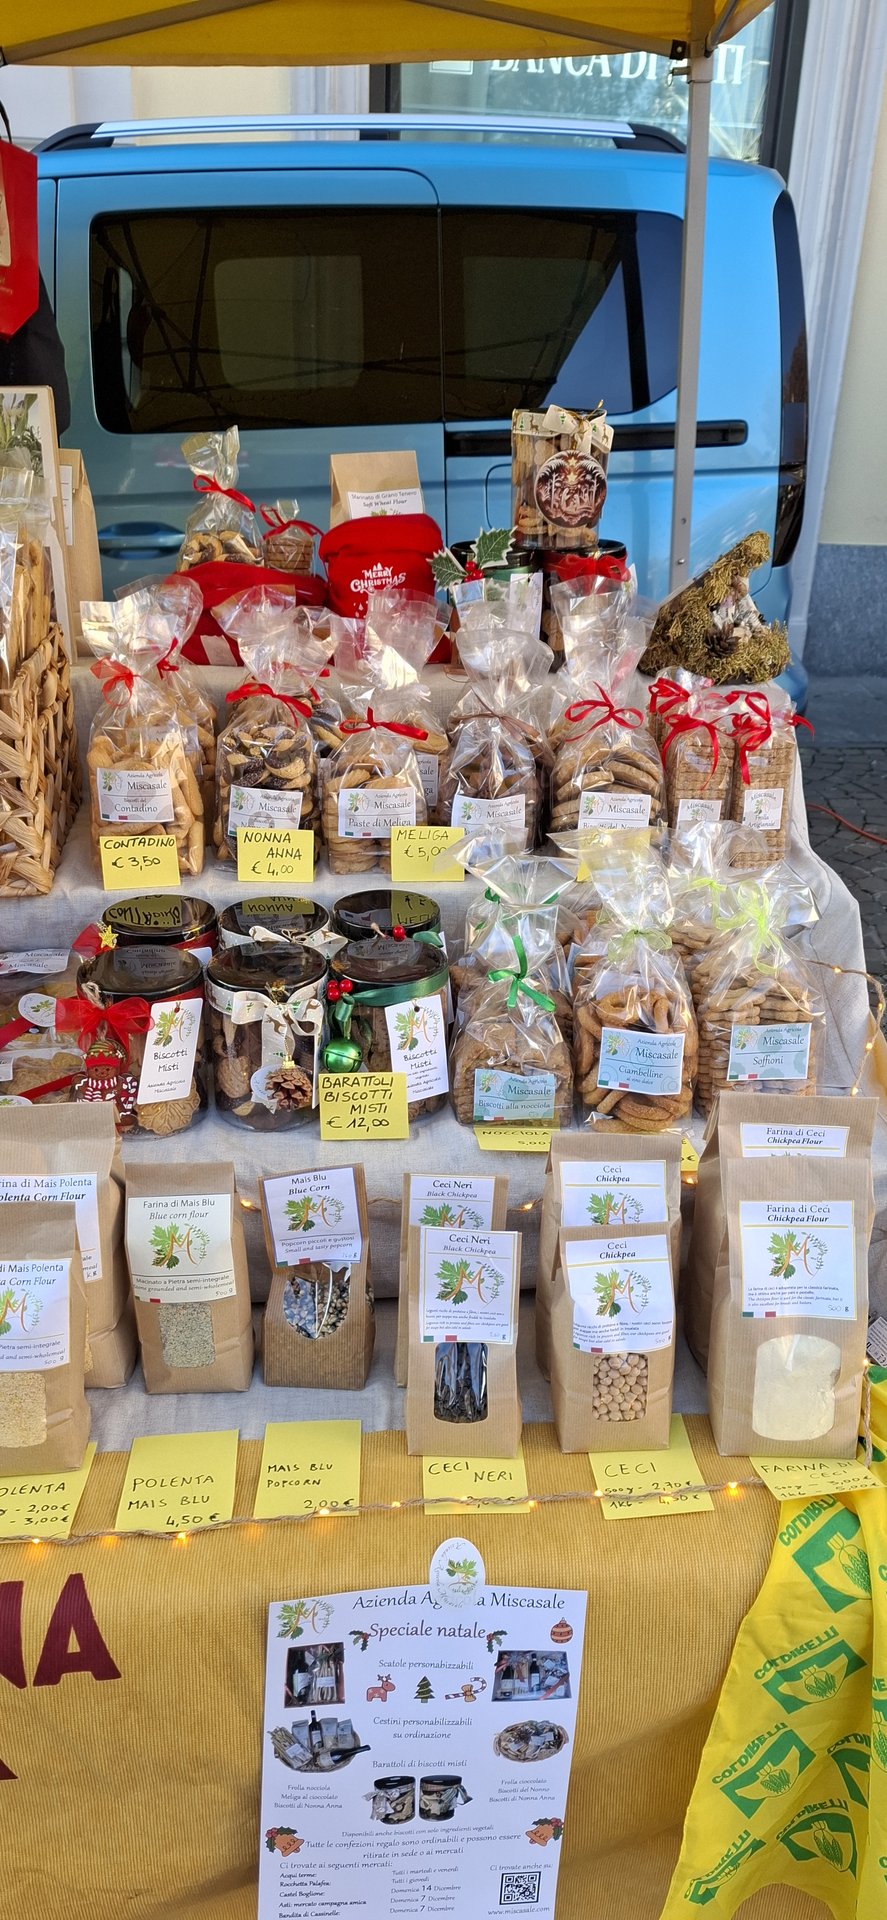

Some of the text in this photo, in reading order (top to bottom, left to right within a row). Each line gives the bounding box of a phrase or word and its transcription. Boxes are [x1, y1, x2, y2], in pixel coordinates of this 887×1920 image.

[362, 566, 393, 579] MERRY
[350, 572, 407, 594] CHRISTMAS
[127, 781, 167, 791] Miscasale
[115, 803, 158, 814] Contadino
[258, 802, 297, 814] Miscasale
[374, 800, 411, 811] Miscasale
[608, 804, 646, 815] Miscasale
[486, 805, 522, 819] Miscasale
[348, 817, 371, 827] Paste
[372, 816, 382, 827] di
[243, 832, 292, 844] NONNA
[397, 829, 448, 841] MELIGA
[103, 837, 176, 850] CONTADINO
[265, 846, 302, 861] ANNA
[404, 845, 415, 858] €
[111, 855, 161, 871] € 3,50
[251, 860, 295, 877] € 4,00
[763, 1035, 804, 1046] Miscasale
[153, 1048, 188, 1060] Biscotti
[403, 1049, 437, 1062] Biscotti
[635, 1046, 679, 1060] Miscasale
[410, 1059, 432, 1070] Misti
[753, 1055, 783, 1068] Soffioni
[158, 1063, 179, 1072] Misti
[619, 1065, 663, 1079] Ciambelline
[322, 1076, 394, 1088] BARATTOLI
[507, 1085, 551, 1096] Miscasale
[324, 1090, 393, 1103] BISCOTTI
[350, 1104, 388, 1115] MISTI
[478, 1100, 504, 1110] Biscotti
[505, 1101, 519, 1109] alla
[326, 1117, 389, 1132] € 12,00
[766, 1128, 792, 1136] Farina
[806, 1129, 826, 1137] Ceci
[767, 1137, 800, 1146] Chickpea
[603, 1165, 622, 1173] Ceci
[20, 1178, 92, 1188] di Mais Polenta
[432, 1180, 451, 1188] Ceci
[596, 1175, 630, 1184] Chickpea
[309, 1185, 331, 1193] Corn
[33, 1192, 86, 1201] Corn Flour
[143, 1200, 168, 1208] Farina
[180, 1199, 199, 1207] Mais
[201, 1198, 215, 1206] Blu
[149, 1212, 167, 1220] Blue
[188, 1210, 209, 1220] flour
[766, 1205, 831, 1214] Farina di Ceci
[767, 1215, 829, 1225] Chickpea Flour
[449, 1234, 491, 1244] Ceci Neri
[464, 1247, 496, 1255] Chickpea
[607, 1242, 627, 1250] Ceci
[599, 1252, 636, 1260] Chickpea
[31, 1264, 64, 1272] Polenta
[33, 1276, 57, 1285] Flour
[268, 1464, 300, 1473] MAIS
[428, 1461, 470, 1475] CECI
[604, 1462, 656, 1477] CECI
[761, 1463, 830, 1473] FARINA
[474, 1470, 513, 1482] NERI
[810, 1470, 847, 1479] CECI
[133, 1475, 214, 1492] POLENTA
[267, 1479, 321, 1488] POPCORN
[128, 1496, 210, 1510] MAIS BLU
[304, 1500, 339, 1512] 2,00
[166, 1513, 220, 1527] 4,50 €
[353, 1591, 417, 1610] Azienda
[490, 1591, 566, 1610] Miscasale
[369, 1620, 486, 1642] Speciale natale
[379, 1659, 407, 1668] Scatole
[373, 1716, 401, 1725] Cestini
[404, 1730, 452, 1739] ordinazione
[372, 1759, 468, 1769] Barattoli di biscotti misti
[305, 1840, 323, 1848] Tutte
[335, 1838, 374, 1849] confezioni
[376, 1838, 400, 1848] regalo
[421, 1836, 459, 1845] ordinabili
[467, 1836, 497, 1844] possono
[363, 1850, 389, 1859] ritirate
[399, 1849, 418, 1857] sede
[435, 1847, 464, 1856] mercati
[279, 1861, 287, 1869] Ci
[289, 1861, 318, 1869] trovate
[328, 1861, 360, 1871] seguenti
[361, 1860, 393, 1868] mercati:
[487, 1906, 550, 1915] www.miscasale.com
